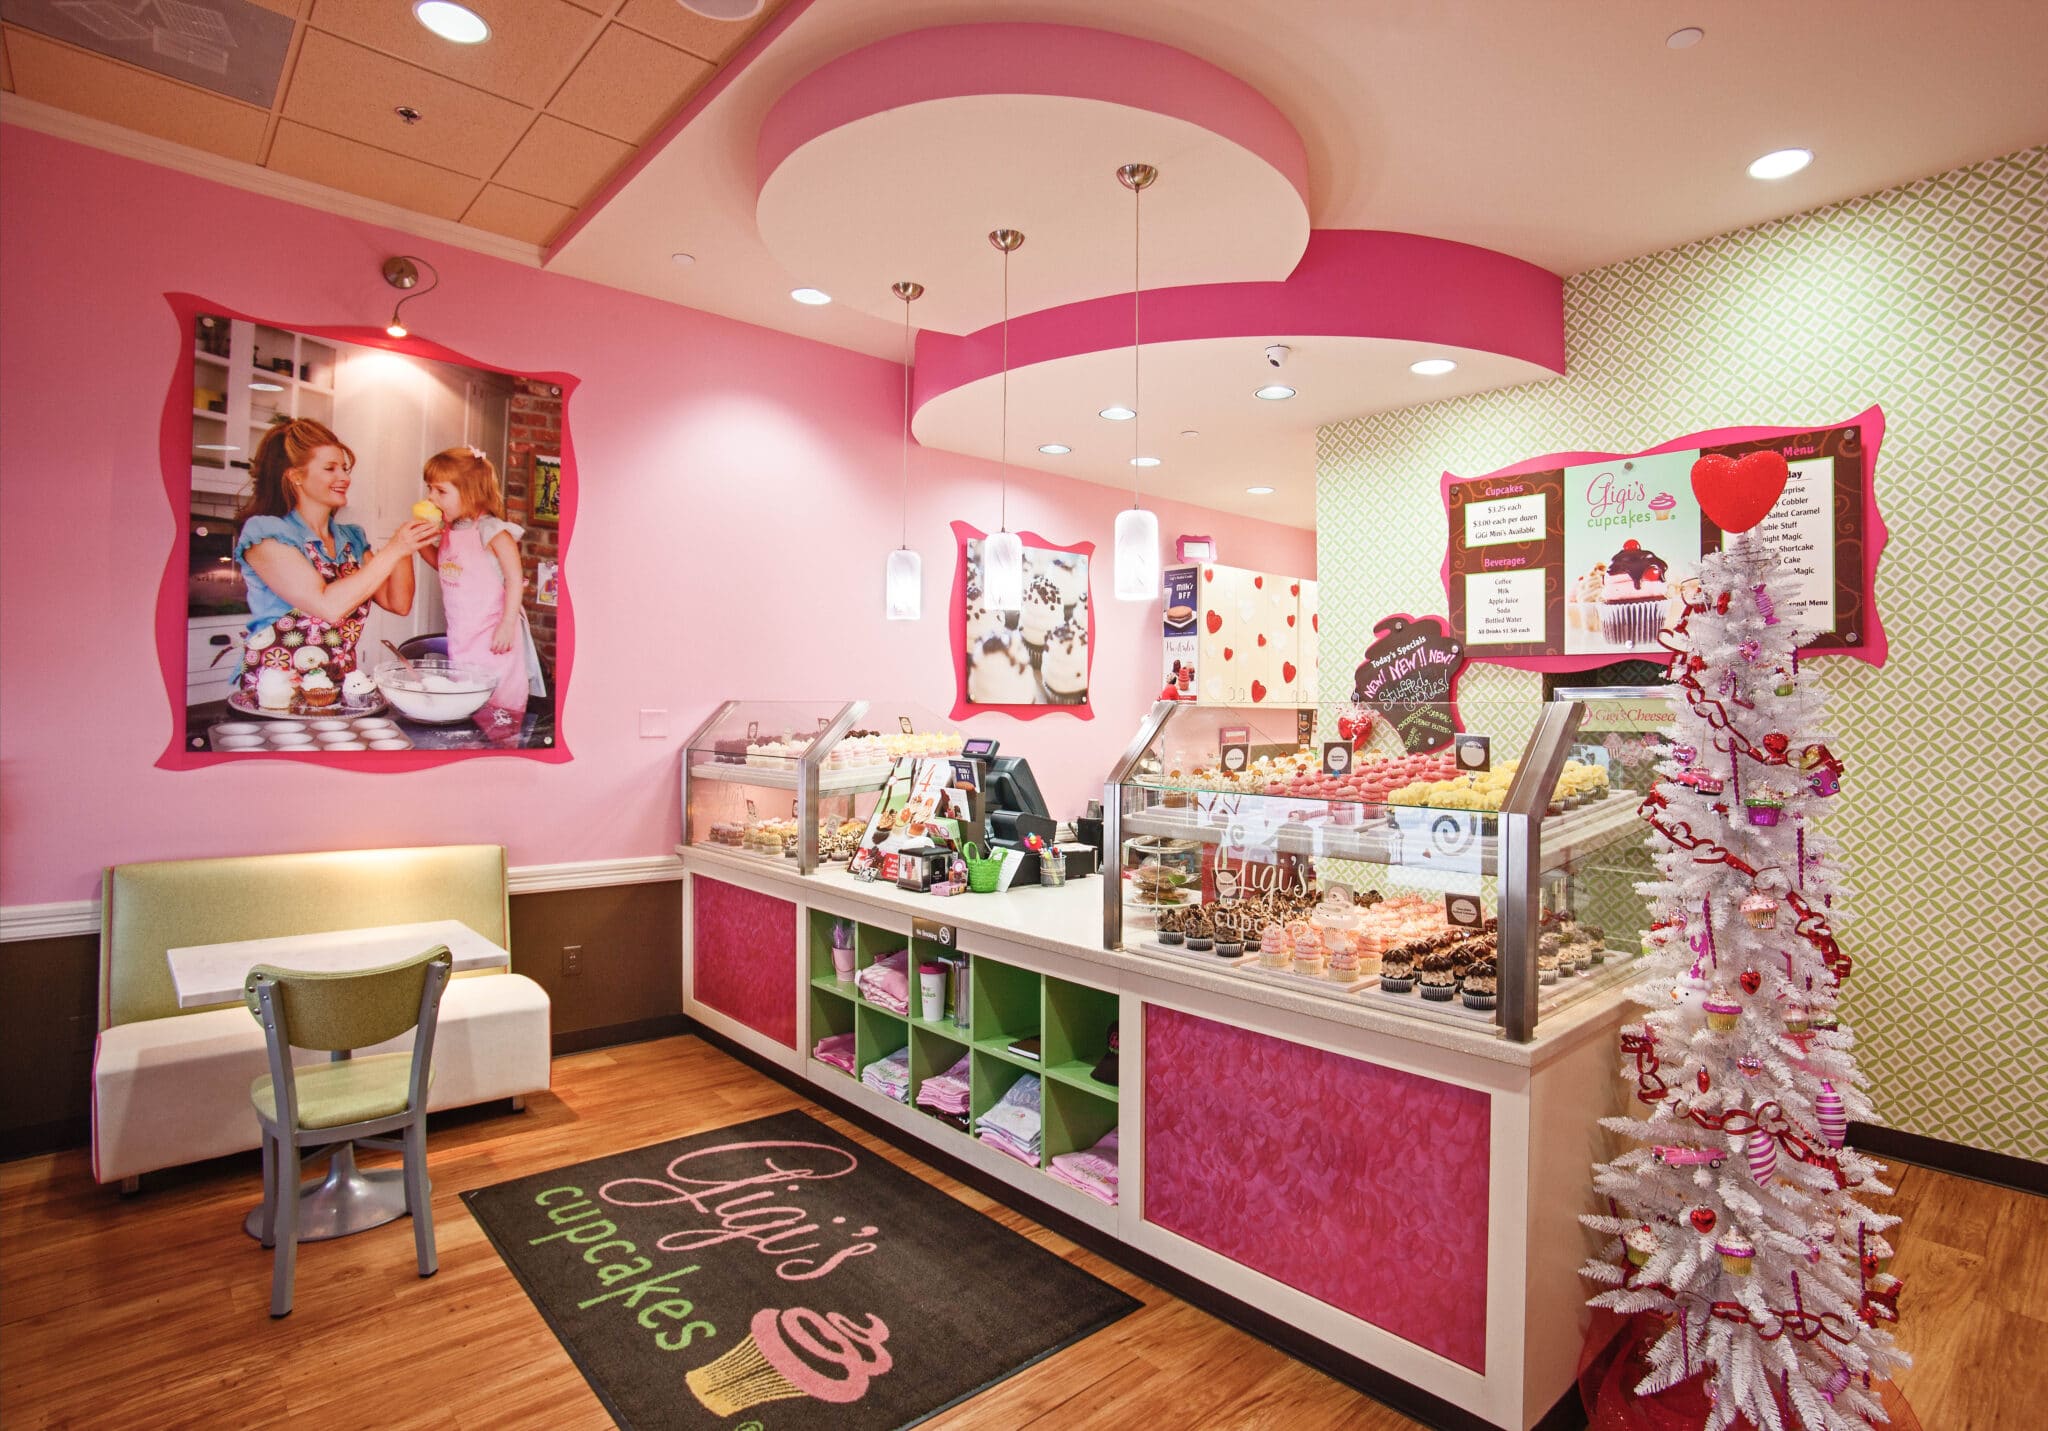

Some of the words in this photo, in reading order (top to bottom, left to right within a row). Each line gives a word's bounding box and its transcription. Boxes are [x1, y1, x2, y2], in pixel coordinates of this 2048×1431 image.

[1783, 446, 1815, 457] Menu
[1485, 484, 1524, 496] Cupcakes
[1587, 472, 1645, 517] Gigi's
[1782, 486, 1806, 495] urprise
[1508, 503, 1522, 511] each
[1782, 498, 1808, 506] Cobbler
[1520, 514, 1538, 522] dozen
[1768, 511, 1788, 519] Salted
[1791, 507, 1820, 517] Caramel
[1587, 509, 1651, 531] cupcakes
[1781, 521, 1797, 529] Stuff
[1508, 526, 1536, 535] Available
[1763, 535, 1780, 544] night
[1782, 533, 1803, 542] Magic
[1779, 544, 1814, 552] Shortcake
[1484, 557, 1526, 568] Beverages
[1488, 598, 1503, 606] Apple
[1371, 651, 1397, 668] Today's
[1396, 635, 1427, 656] Specials
[1364, 669, 1387, 699] NEW!
[1429, 649, 1456, 665] NEW!
[1214, 840, 1307, 914] Gigi's
[600, 1140, 879, 1281] Gigi's
[529, 1186, 717, 1352] cupcakes
